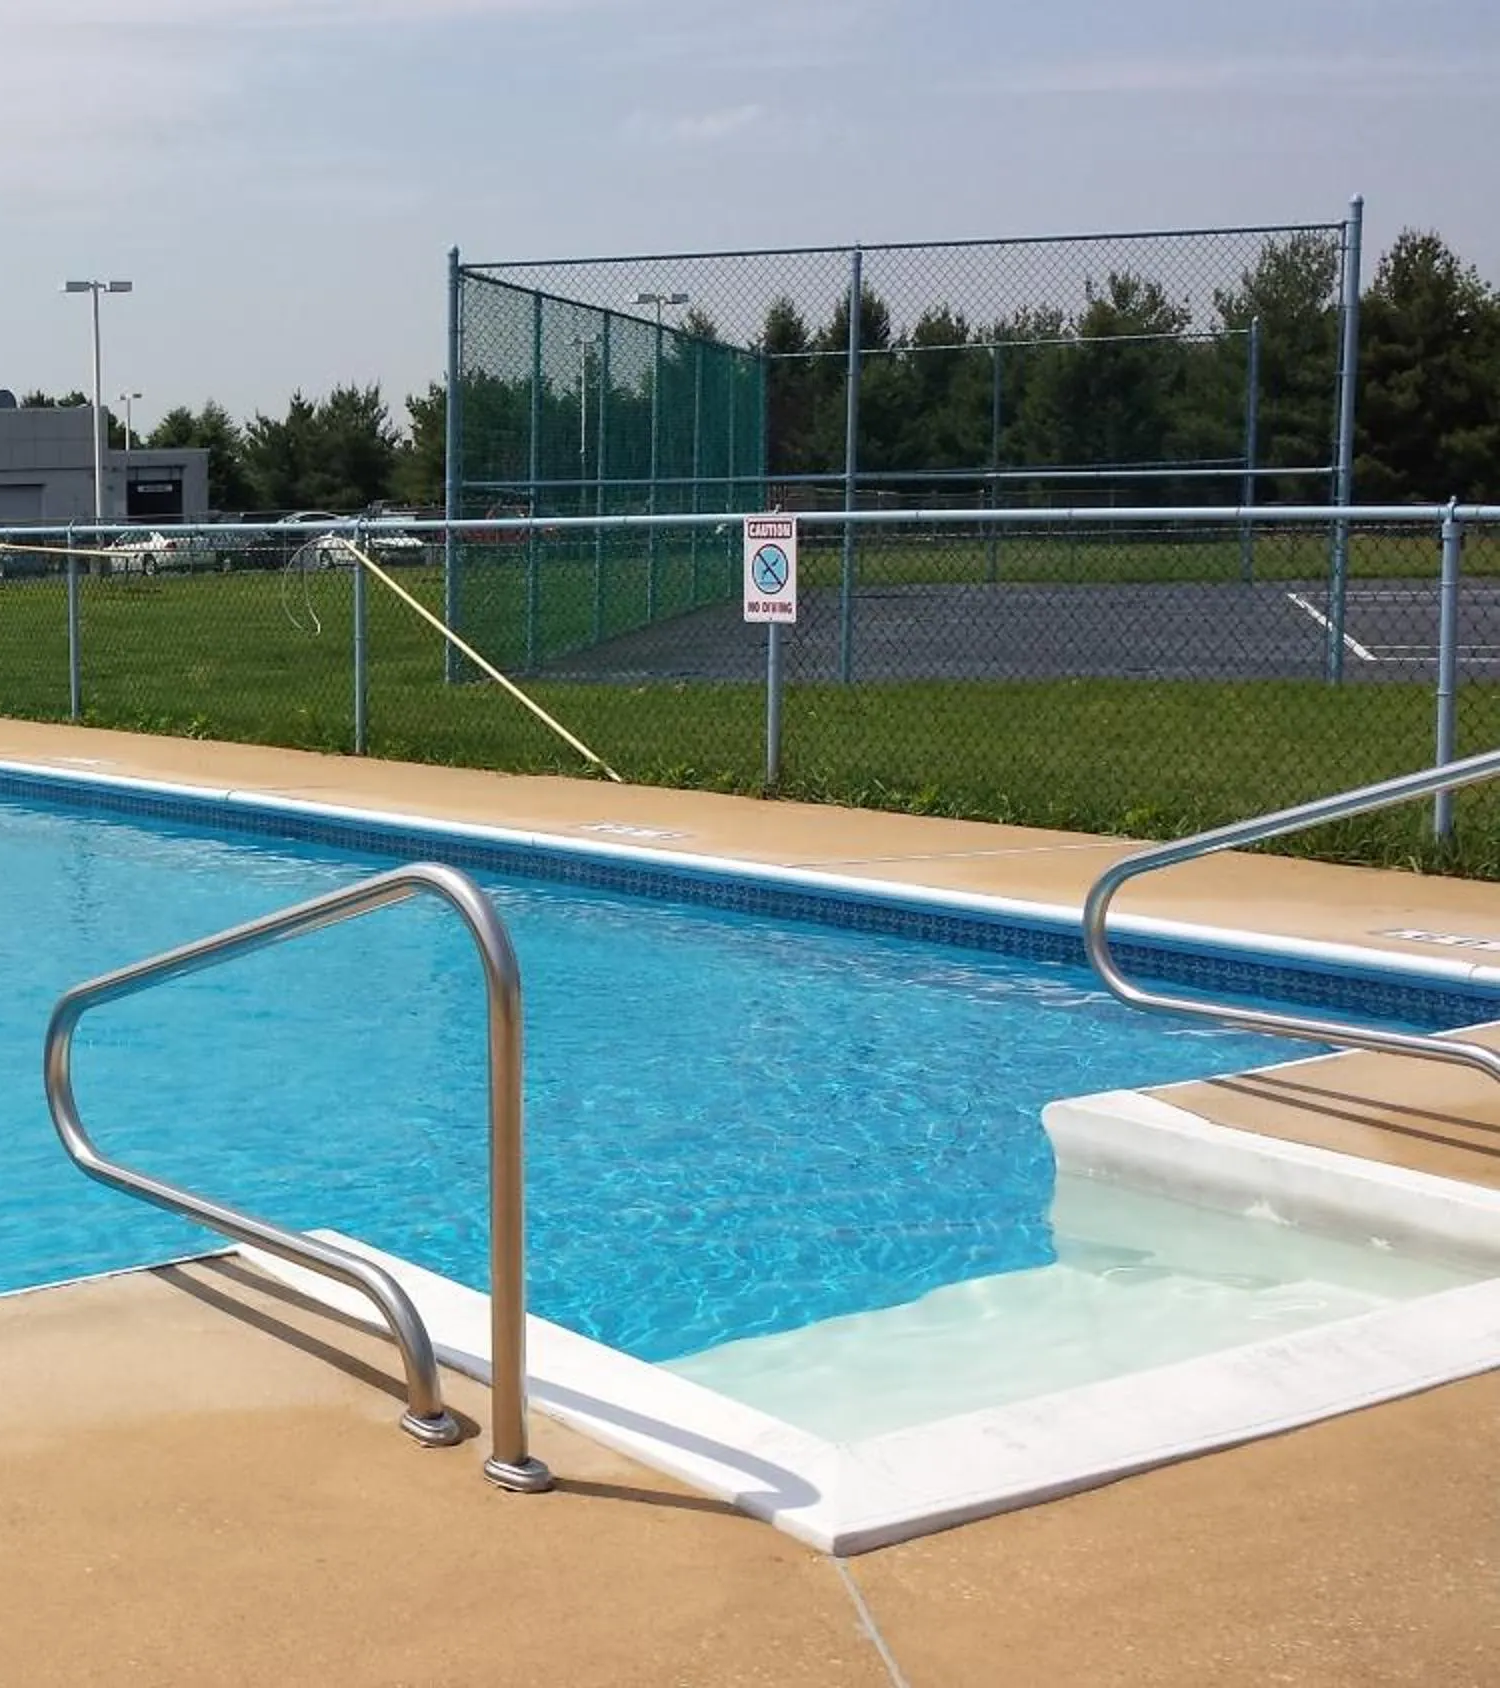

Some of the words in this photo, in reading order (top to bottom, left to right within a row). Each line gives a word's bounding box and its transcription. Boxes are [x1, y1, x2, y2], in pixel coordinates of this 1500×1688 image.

[749, 523, 791, 537] CAUTION
[747, 602, 760, 613] NO
[762, 602, 792, 614] DIVING
